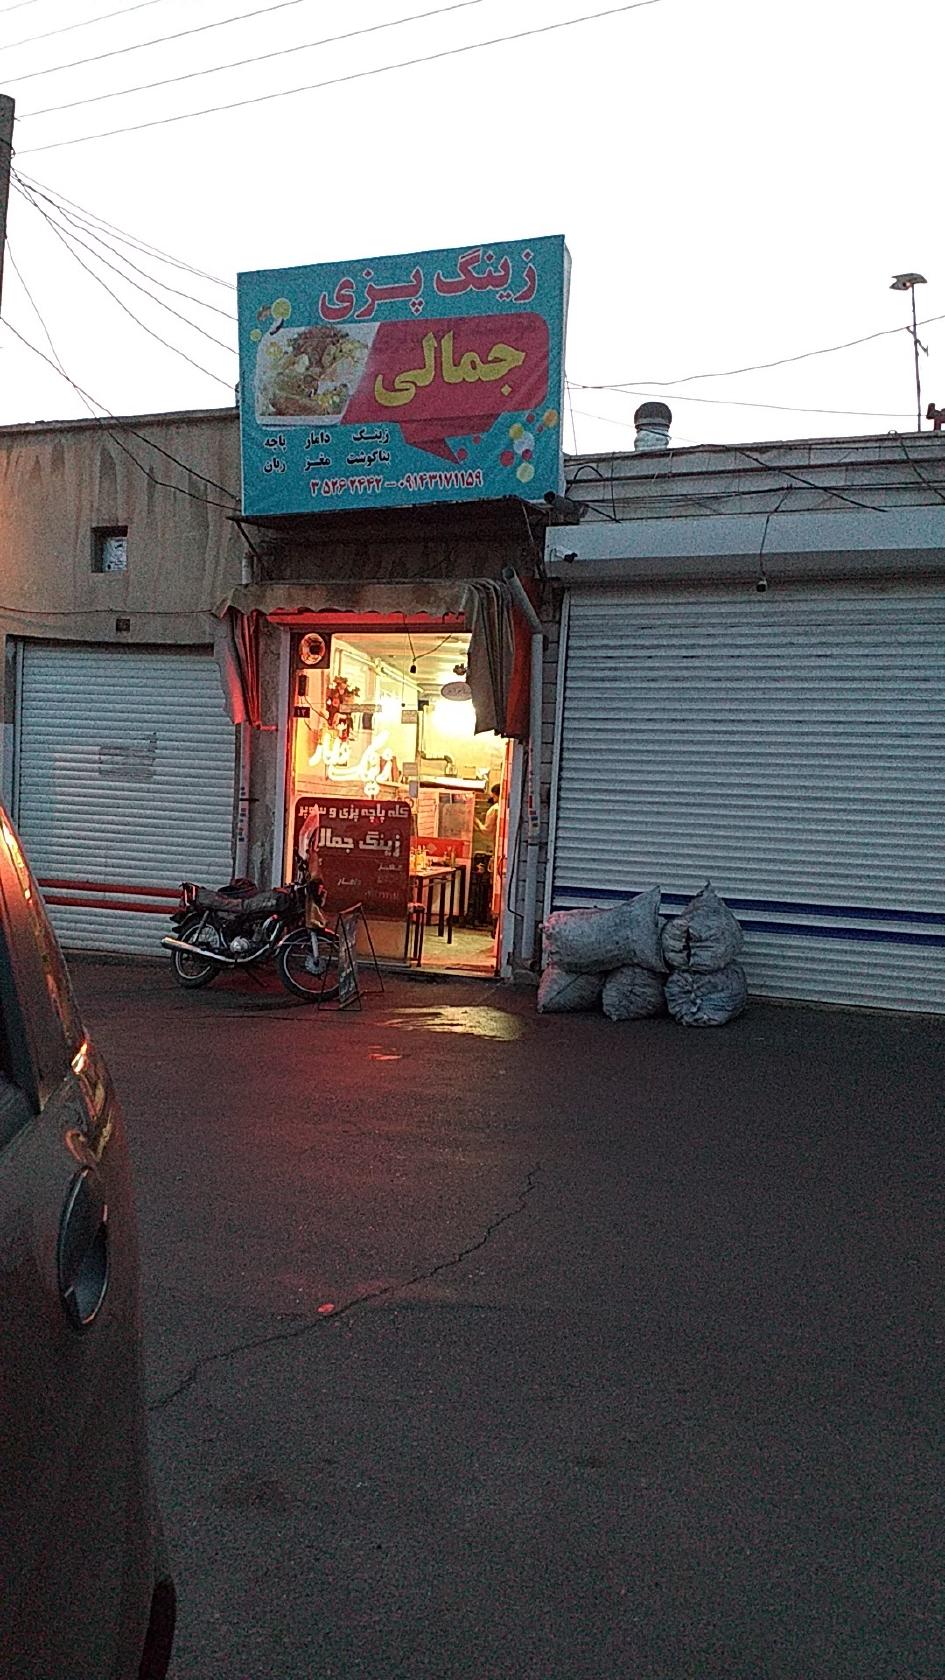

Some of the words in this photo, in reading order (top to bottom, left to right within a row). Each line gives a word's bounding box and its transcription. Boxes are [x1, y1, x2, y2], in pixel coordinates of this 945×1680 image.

[433, 247, 538, 304] زینگ
[319, 265, 424, 322] پزی
[374, 331, 526, 408] جمالی
[304, 451, 332, 472] مغز
[329, 807, 337, 818] و
[339, 804, 360, 822] پزی
[361, 803, 386, 823] پاچه
[388, 804, 409, 818] کله
[359, 831, 401, 857] زینگ
